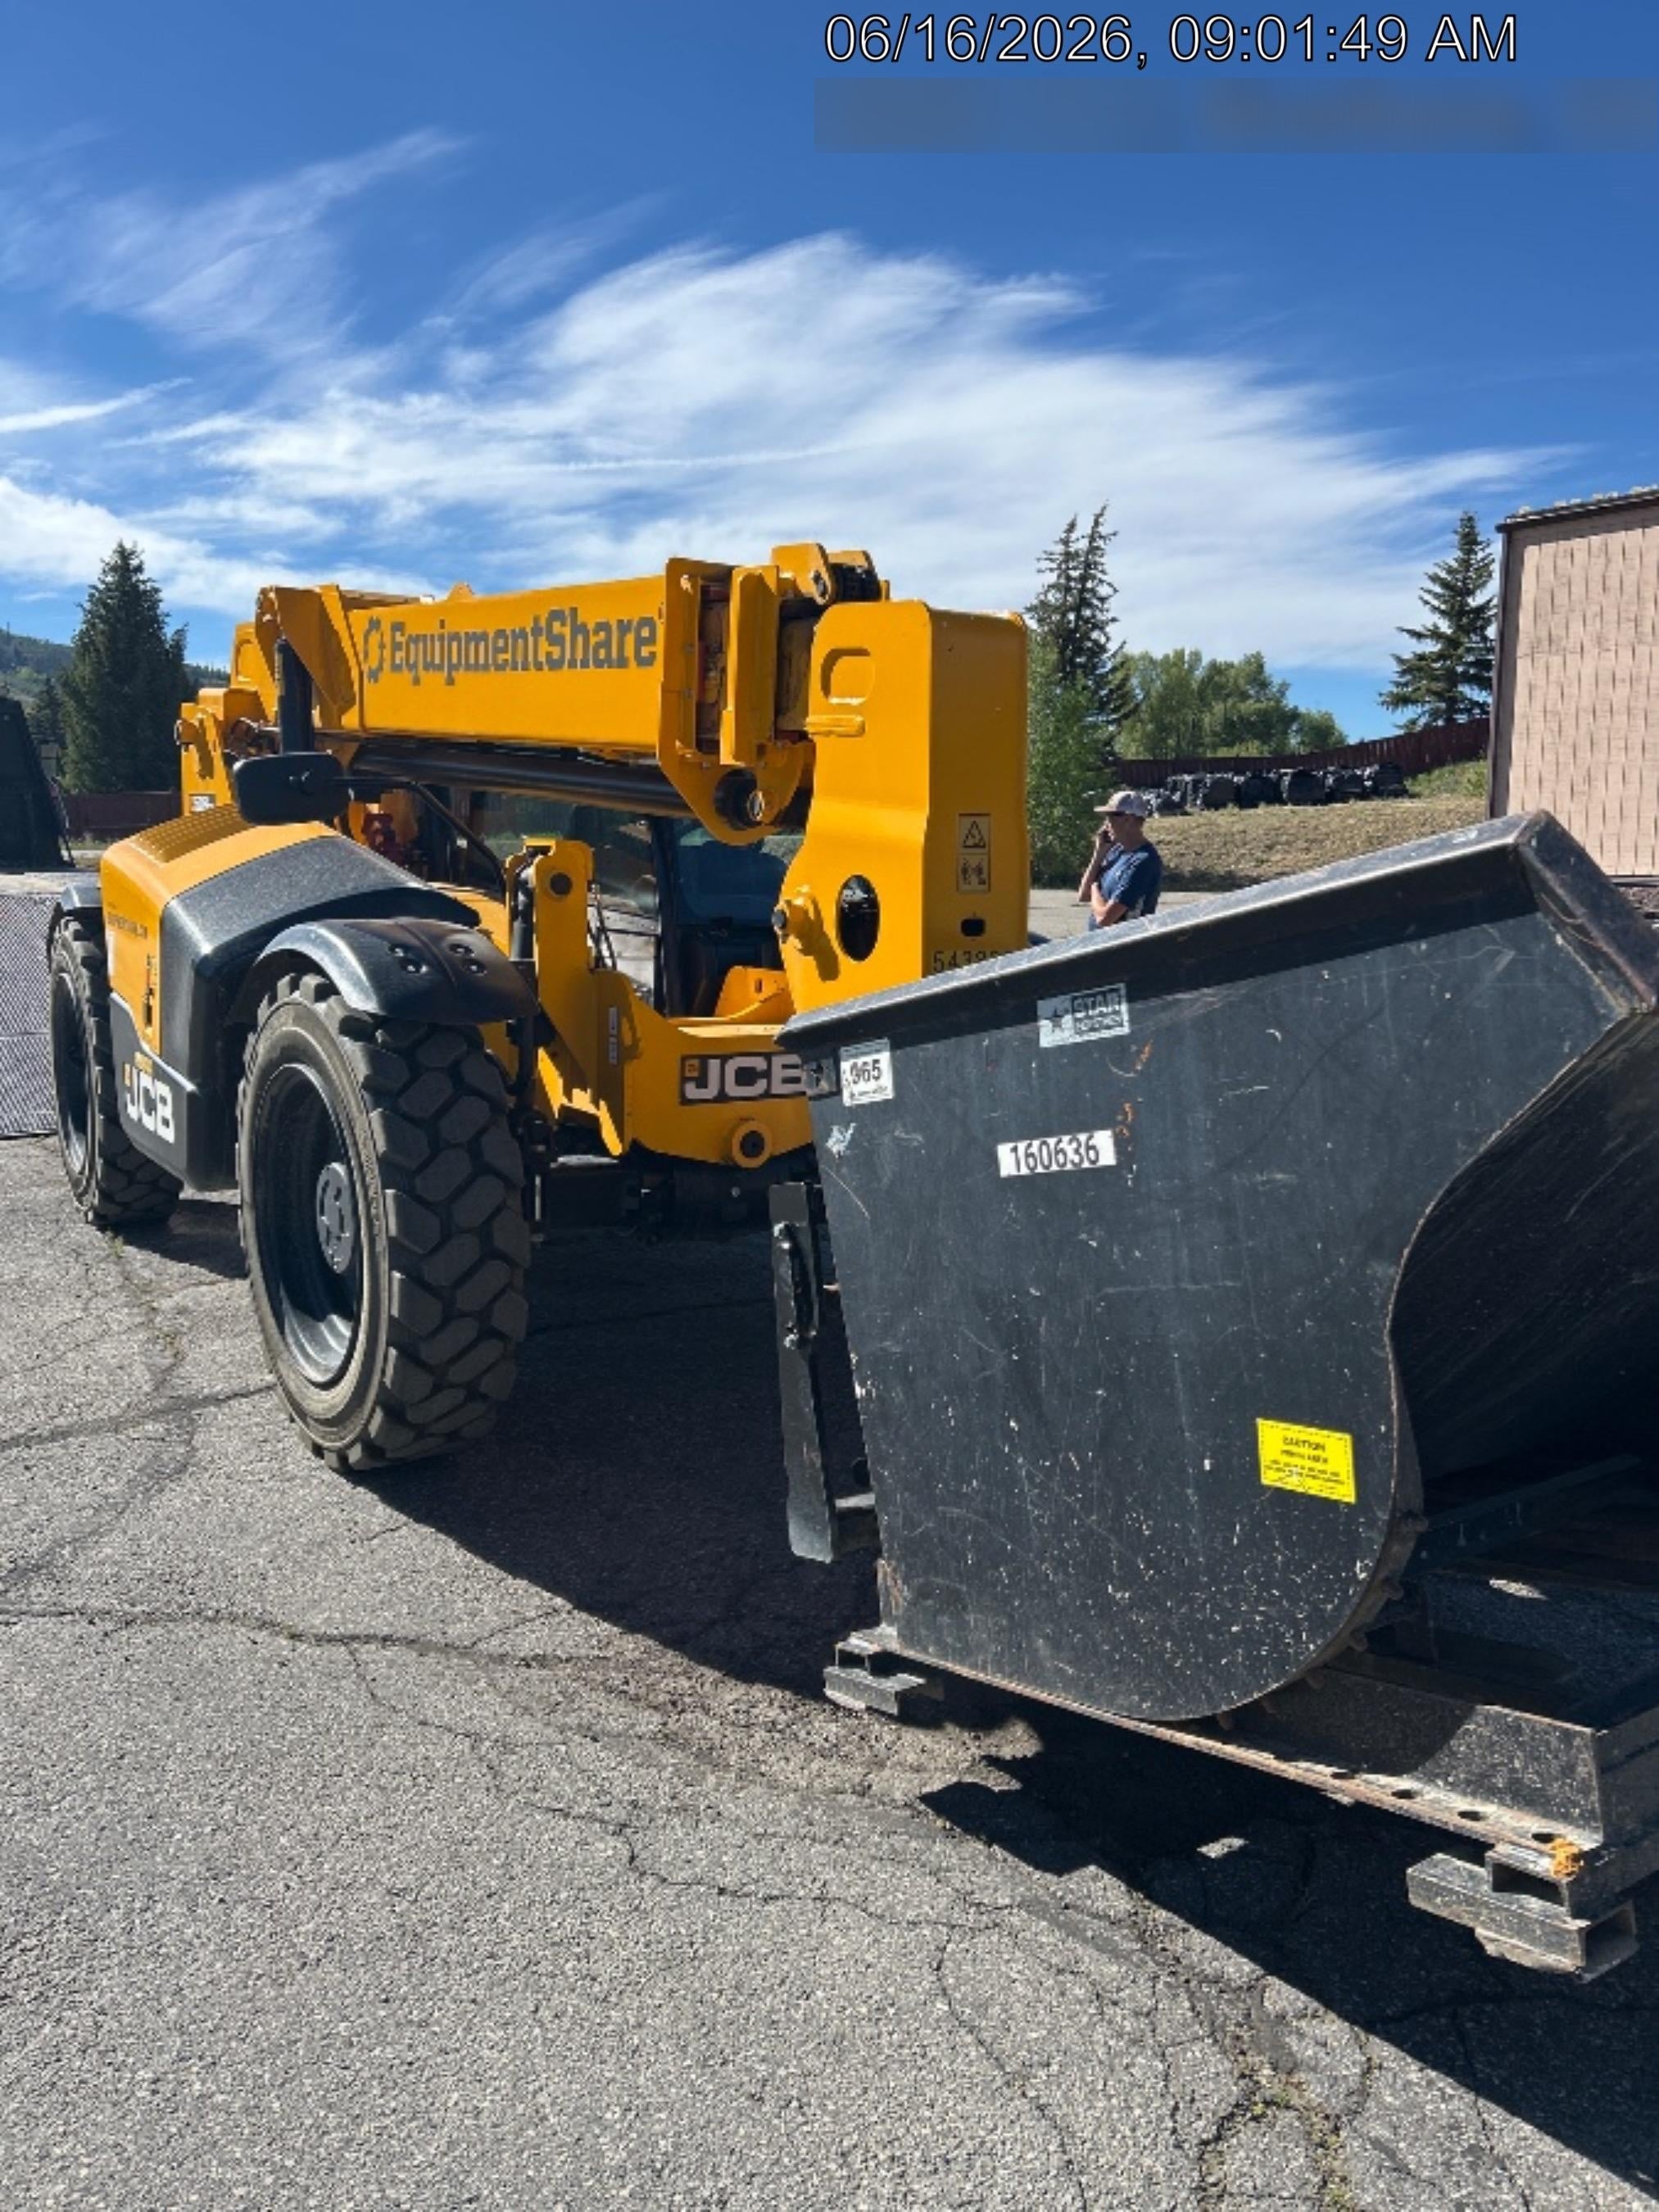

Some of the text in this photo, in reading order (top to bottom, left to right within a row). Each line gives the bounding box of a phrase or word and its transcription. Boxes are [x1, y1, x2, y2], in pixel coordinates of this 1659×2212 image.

[390, 607, 656, 686] EquipmentShare
[126, 1068, 175, 1145] JCB
[684, 1054, 808, 1099] JCB
[1010, 1135, 1099, 1175] 160636
